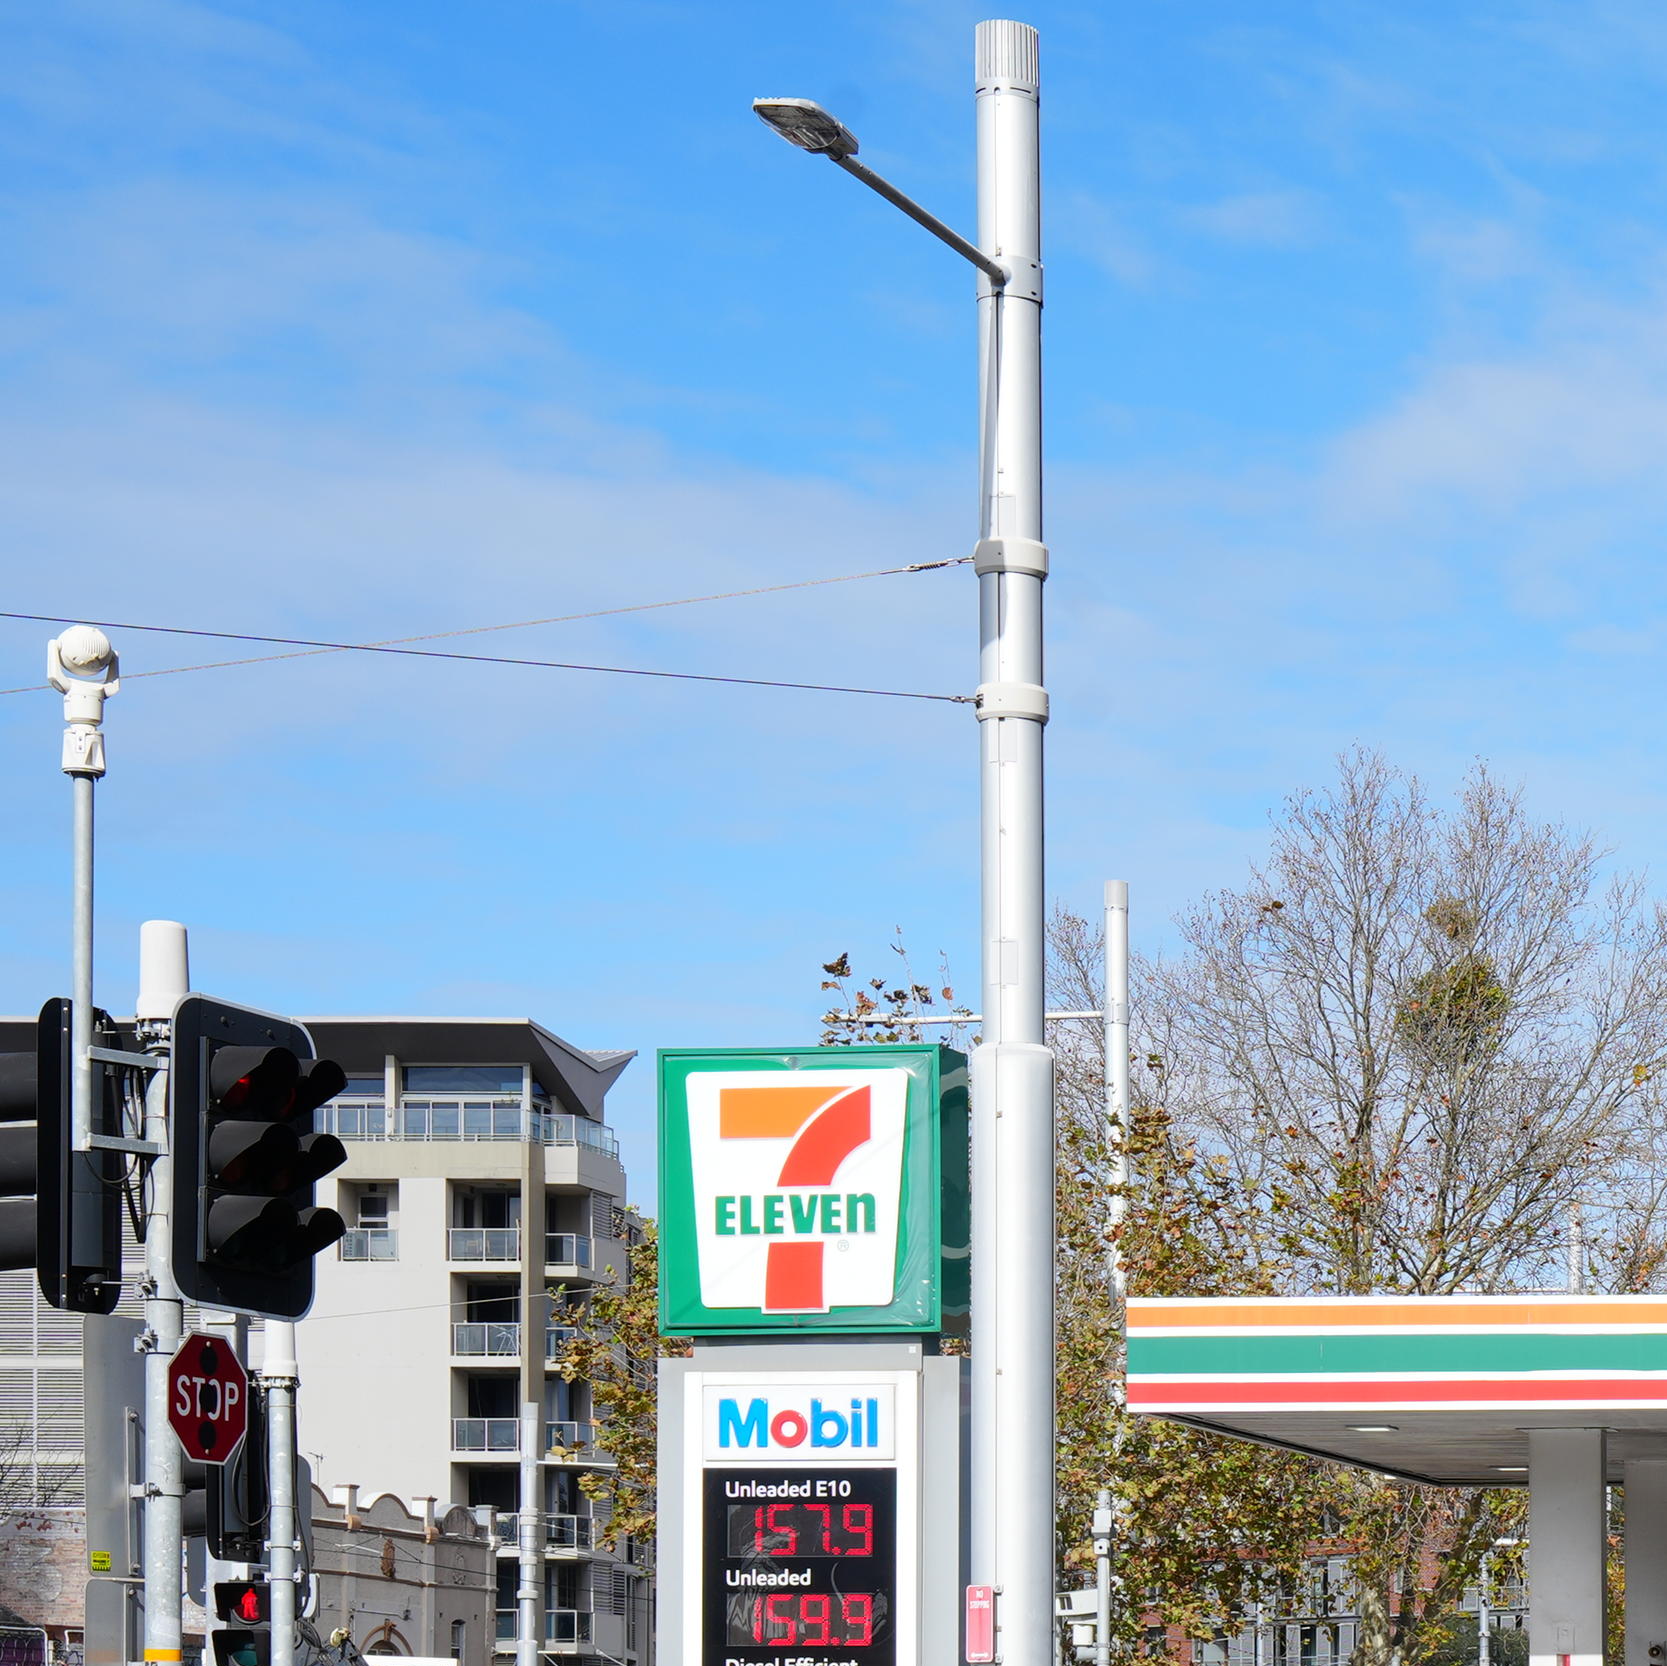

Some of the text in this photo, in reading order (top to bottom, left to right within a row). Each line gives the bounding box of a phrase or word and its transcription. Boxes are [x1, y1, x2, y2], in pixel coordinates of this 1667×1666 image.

[720, 1085, 871, 1308] 7
[176, 1375, 239, 1421] STOP
[719, 1398, 879, 1449] Mobil
[725, 1480, 851, 1497] Unleaded E10
[754, 1504, 874, 1556] 157.9
[726, 1569, 812, 1586] Unleaded
[754, 1594, 873, 1647] 159.9
